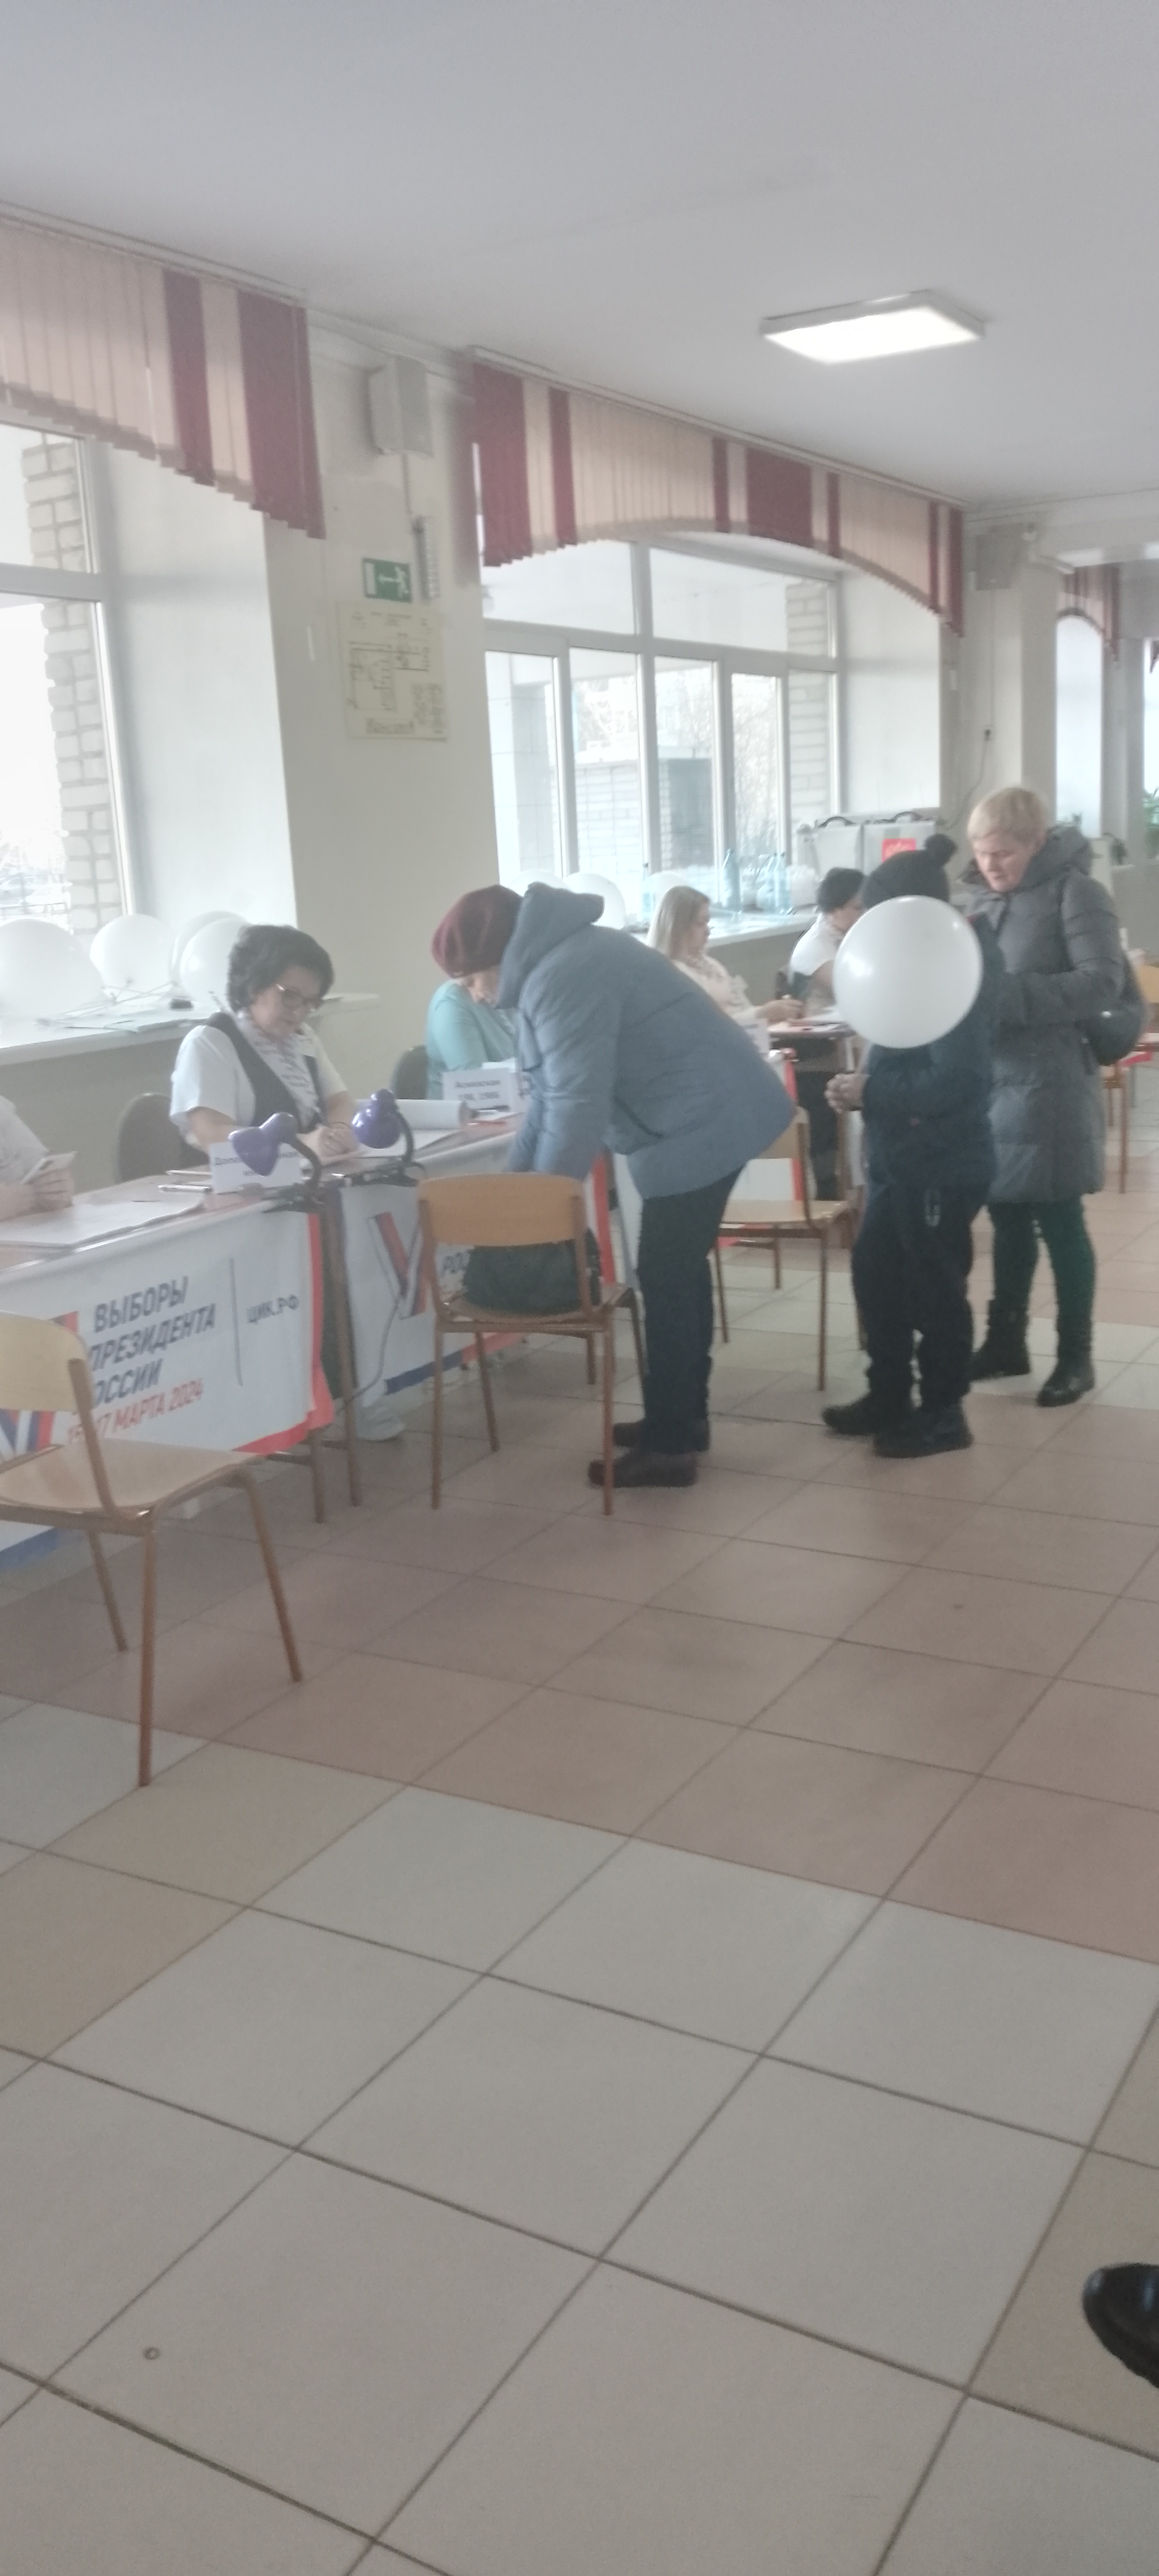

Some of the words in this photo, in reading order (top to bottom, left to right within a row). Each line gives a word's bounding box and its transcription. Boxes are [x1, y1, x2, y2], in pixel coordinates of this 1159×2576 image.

[94, 1276, 188, 1333] ВЫБОРЫ
[246, 1294, 300, 1324] ЦИК.РФ
[89, 1303, 216, 1372] ПРЕЗИДЕНТА
[93, 1358, 163, 1408] ОССИИ
[113, 1393, 165, 1433] МАРТА
[168, 1377, 204, 1412] 2024
